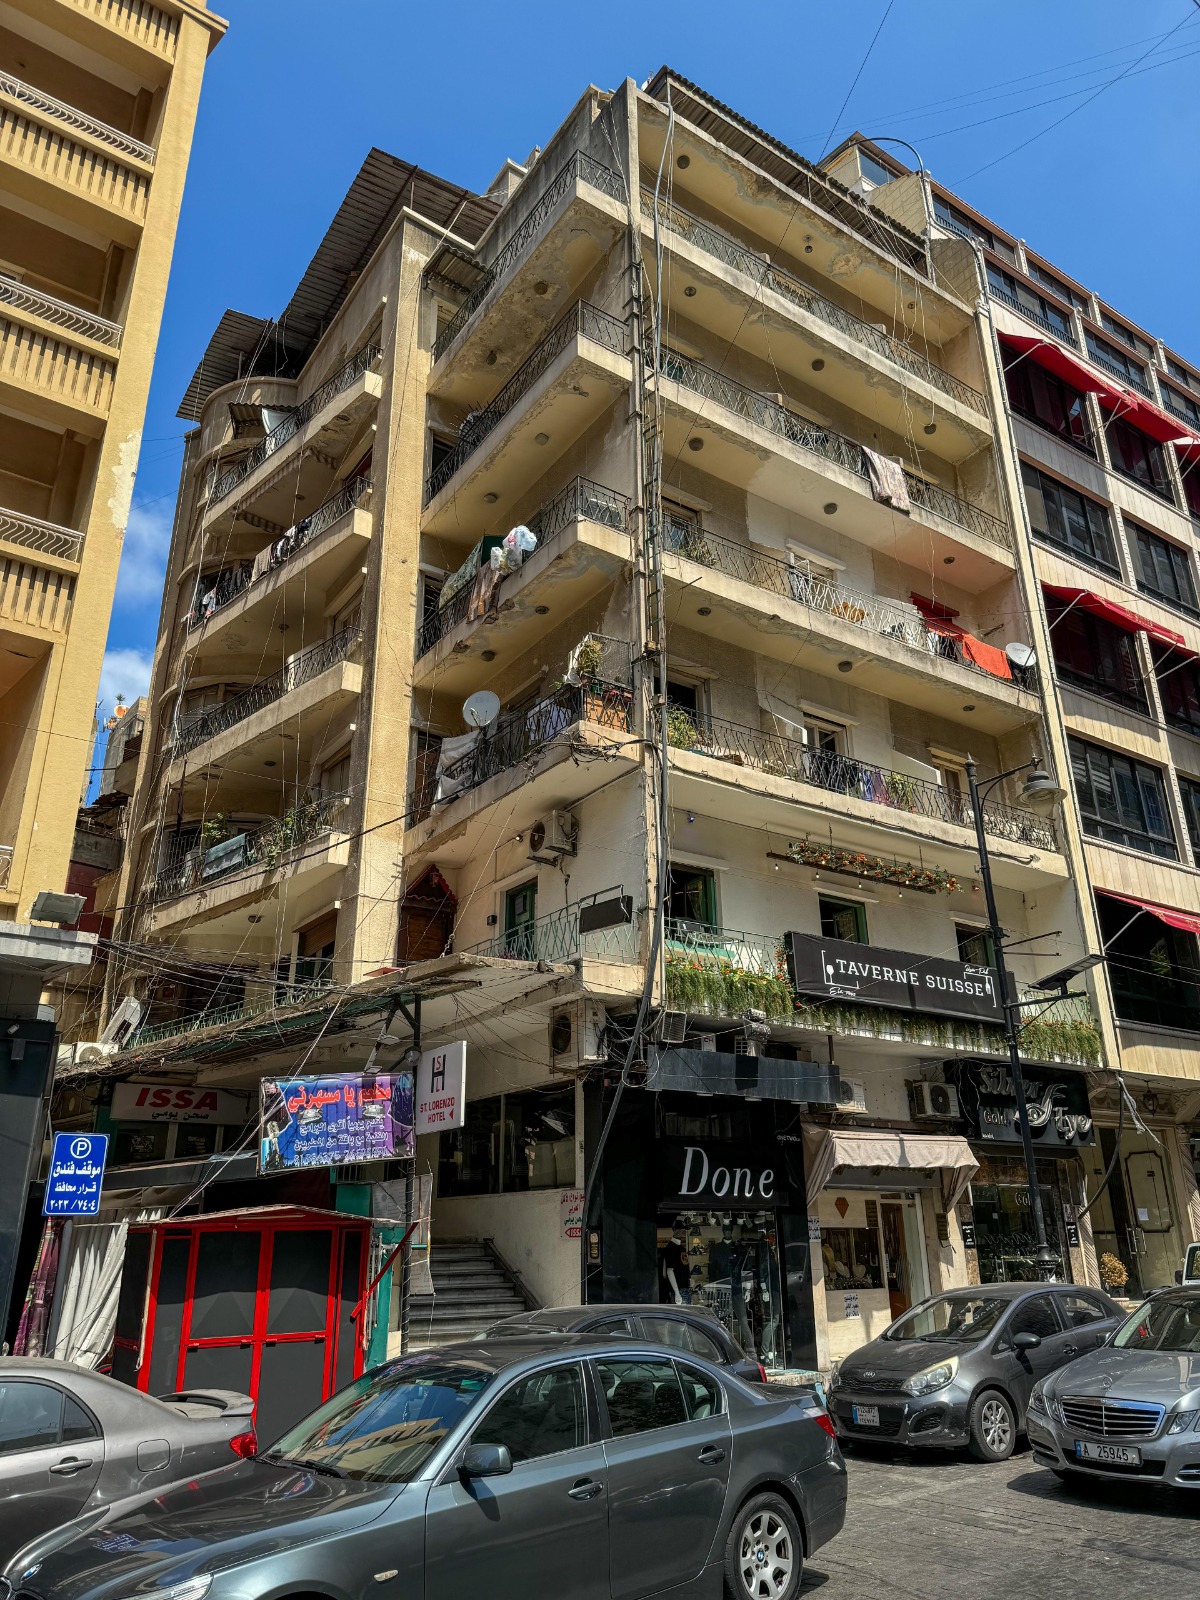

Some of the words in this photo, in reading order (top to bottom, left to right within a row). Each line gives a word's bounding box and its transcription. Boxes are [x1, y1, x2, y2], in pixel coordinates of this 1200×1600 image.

[835, 958, 920, 986] TAVERNE
[925, 974, 985, 997] SUISSE
[135, 1087, 218, 1111] ISSA
[343, 1084, 355, 1108] يا
[358, 1083, 392, 1106] مطعم
[428, 1096, 456, 1112] LORENZO
[151, 1110, 178, 1121] يومي
[182, 1111, 210, 1121] صحن
[427, 1111, 446, 1124] HOTEL
[983, 1109, 1007, 1126] Gold
[76, 1141, 88, 1156] P
[52, 1160, 75, 1178] فندق
[75, 1160, 101, 1179] موقف
[678, 1146, 775, 1198] Done
[54, 1181, 77, 1192] محافظ
[77, 1181, 97, 1195] قرار
[1083, 1443, 1090, 1456] A
[1096, 1445, 1129, 1461] 25945
